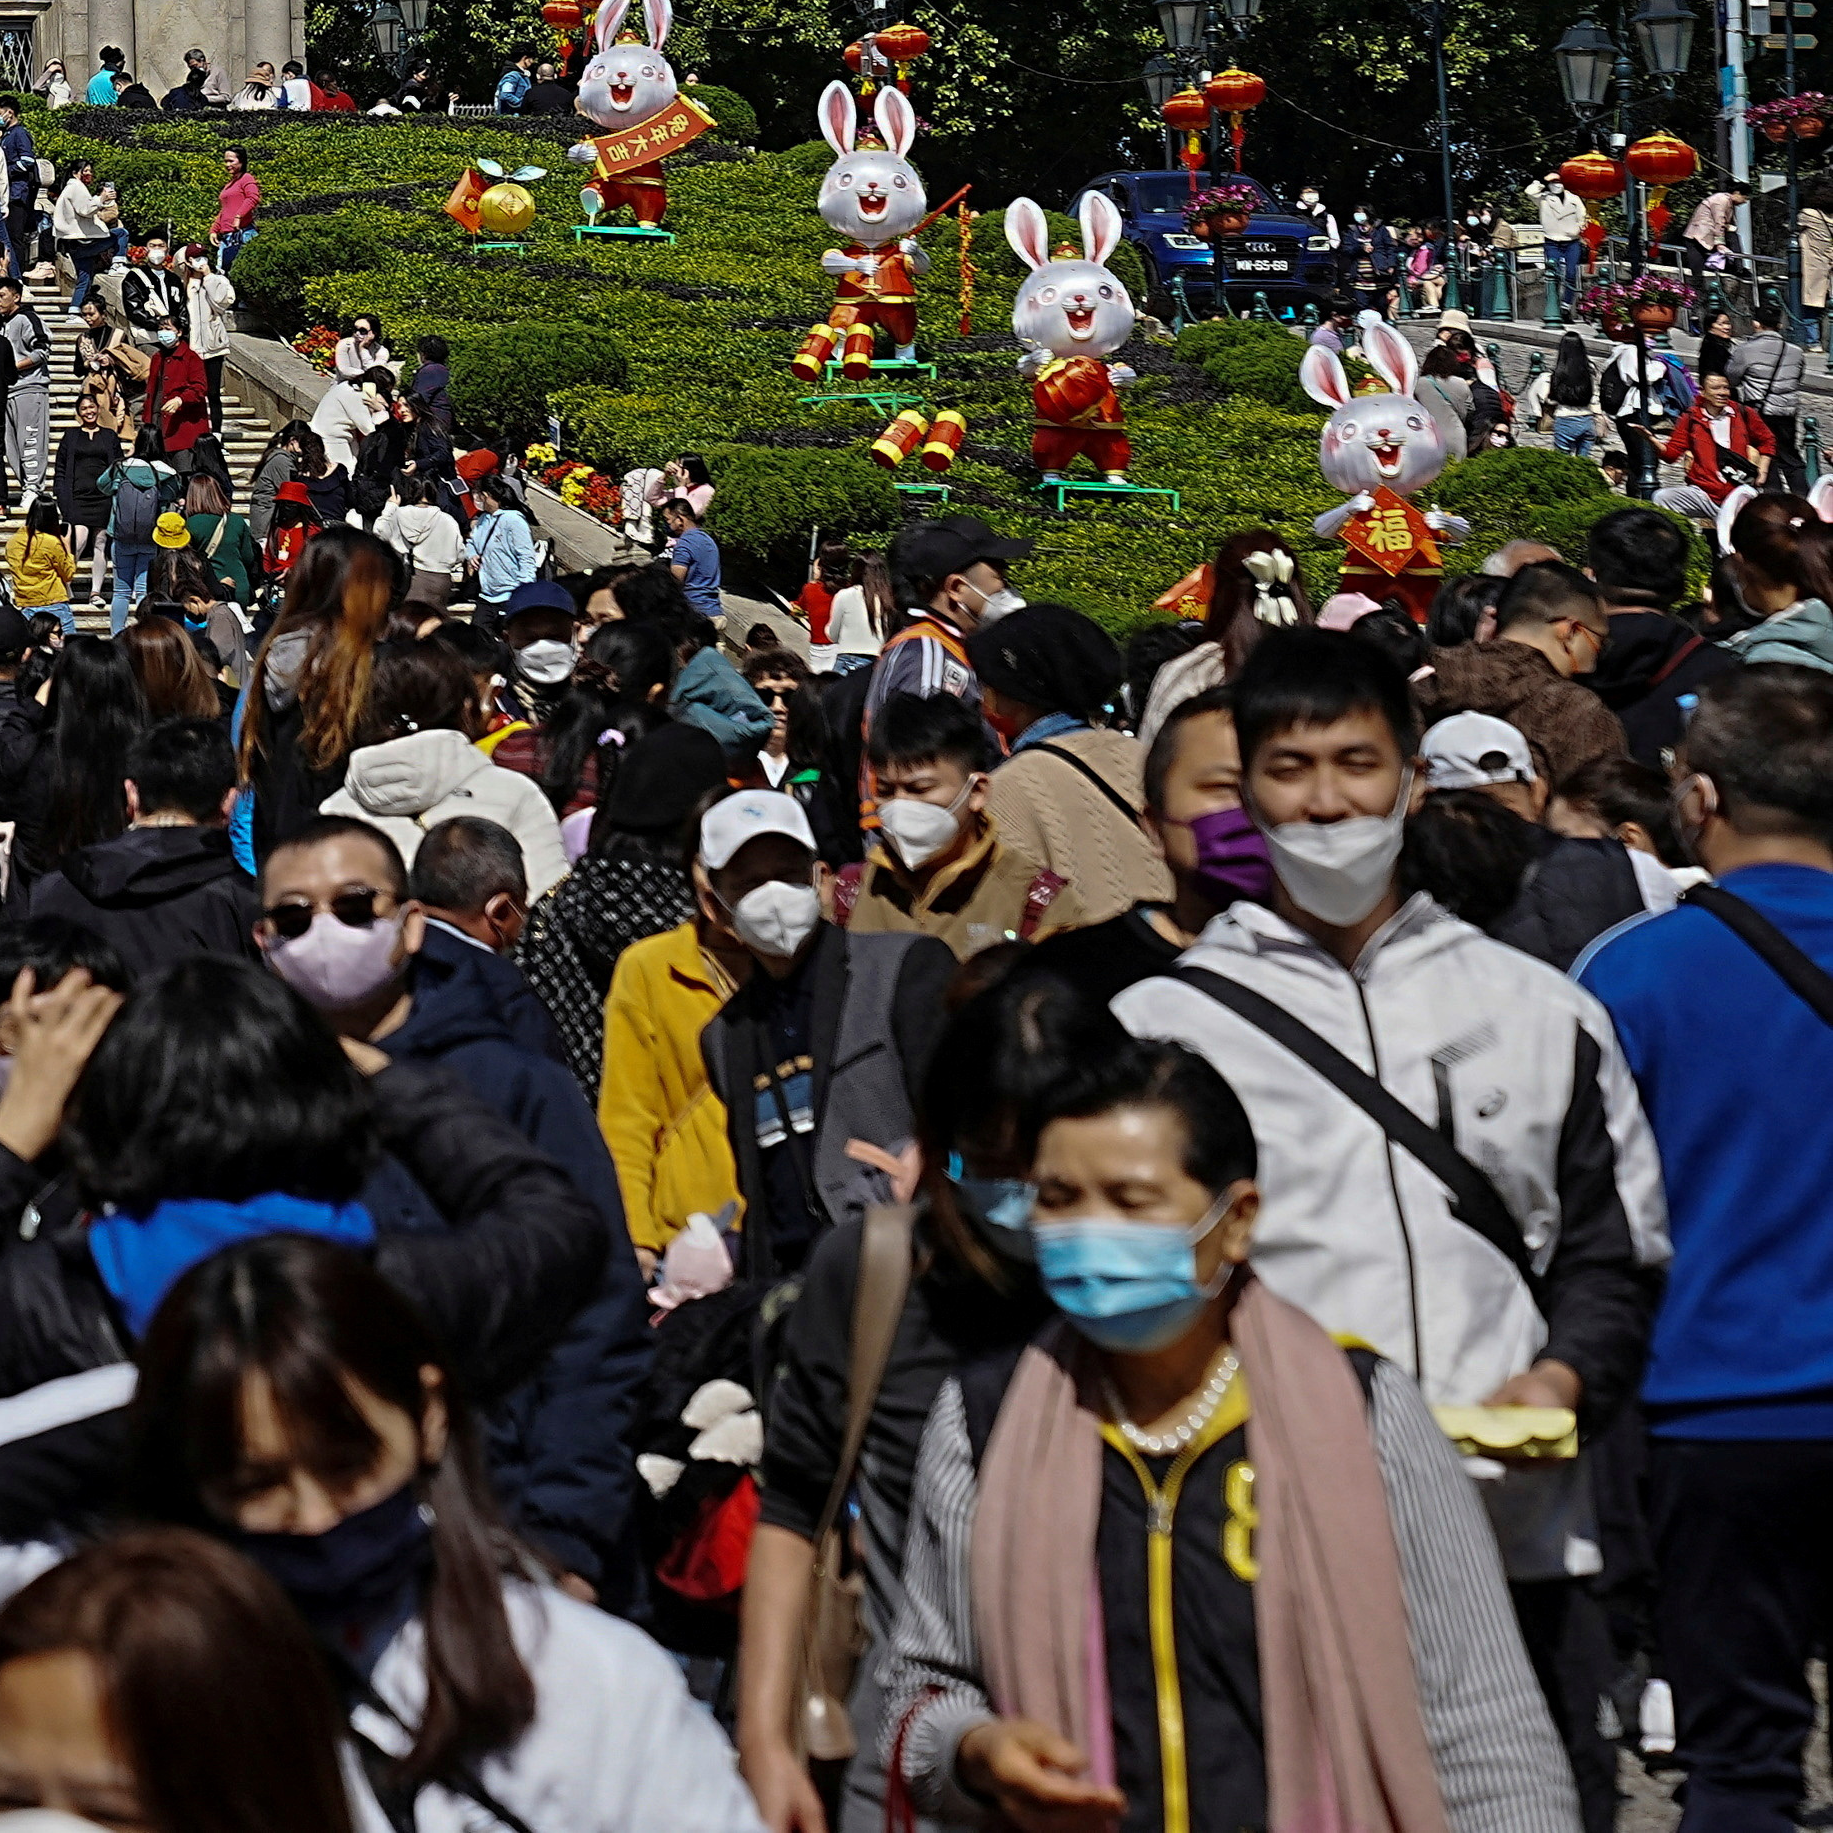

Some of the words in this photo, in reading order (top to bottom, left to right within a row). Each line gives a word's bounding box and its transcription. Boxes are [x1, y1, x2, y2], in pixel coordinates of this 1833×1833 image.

[606, 113, 690, 163] 兔年大吉
[1364, 508, 1414, 553] 福
